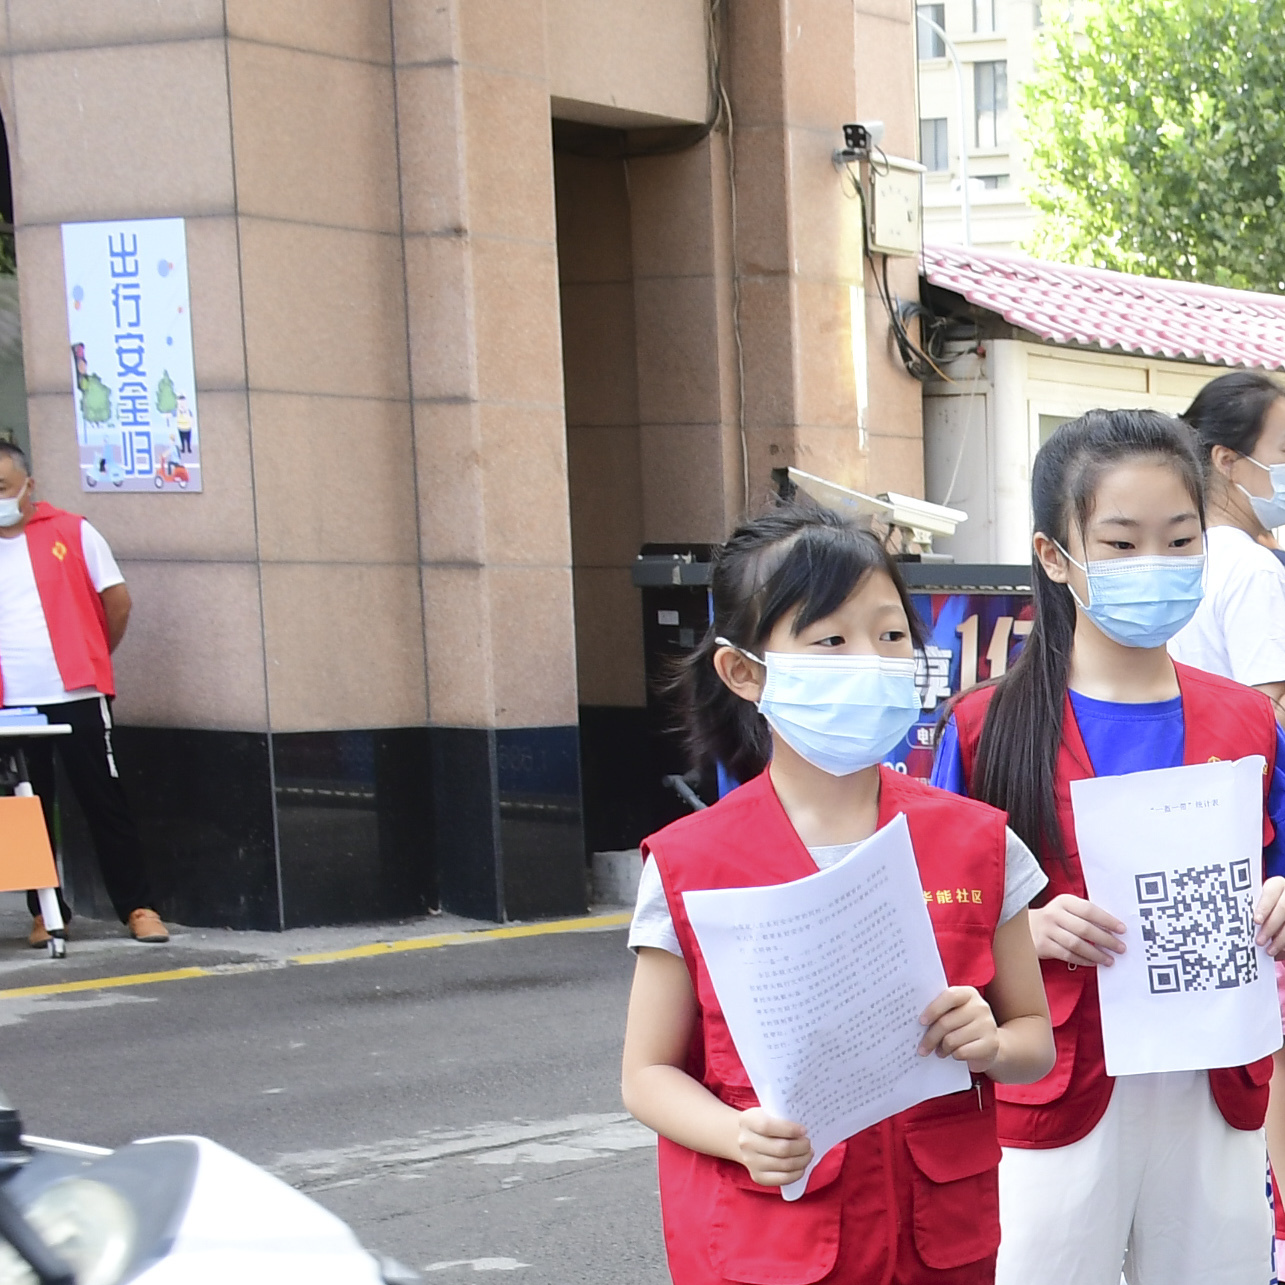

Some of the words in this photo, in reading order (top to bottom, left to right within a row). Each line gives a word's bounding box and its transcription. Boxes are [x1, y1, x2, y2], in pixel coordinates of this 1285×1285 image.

[108, 232, 153, 475] 出行安全归
